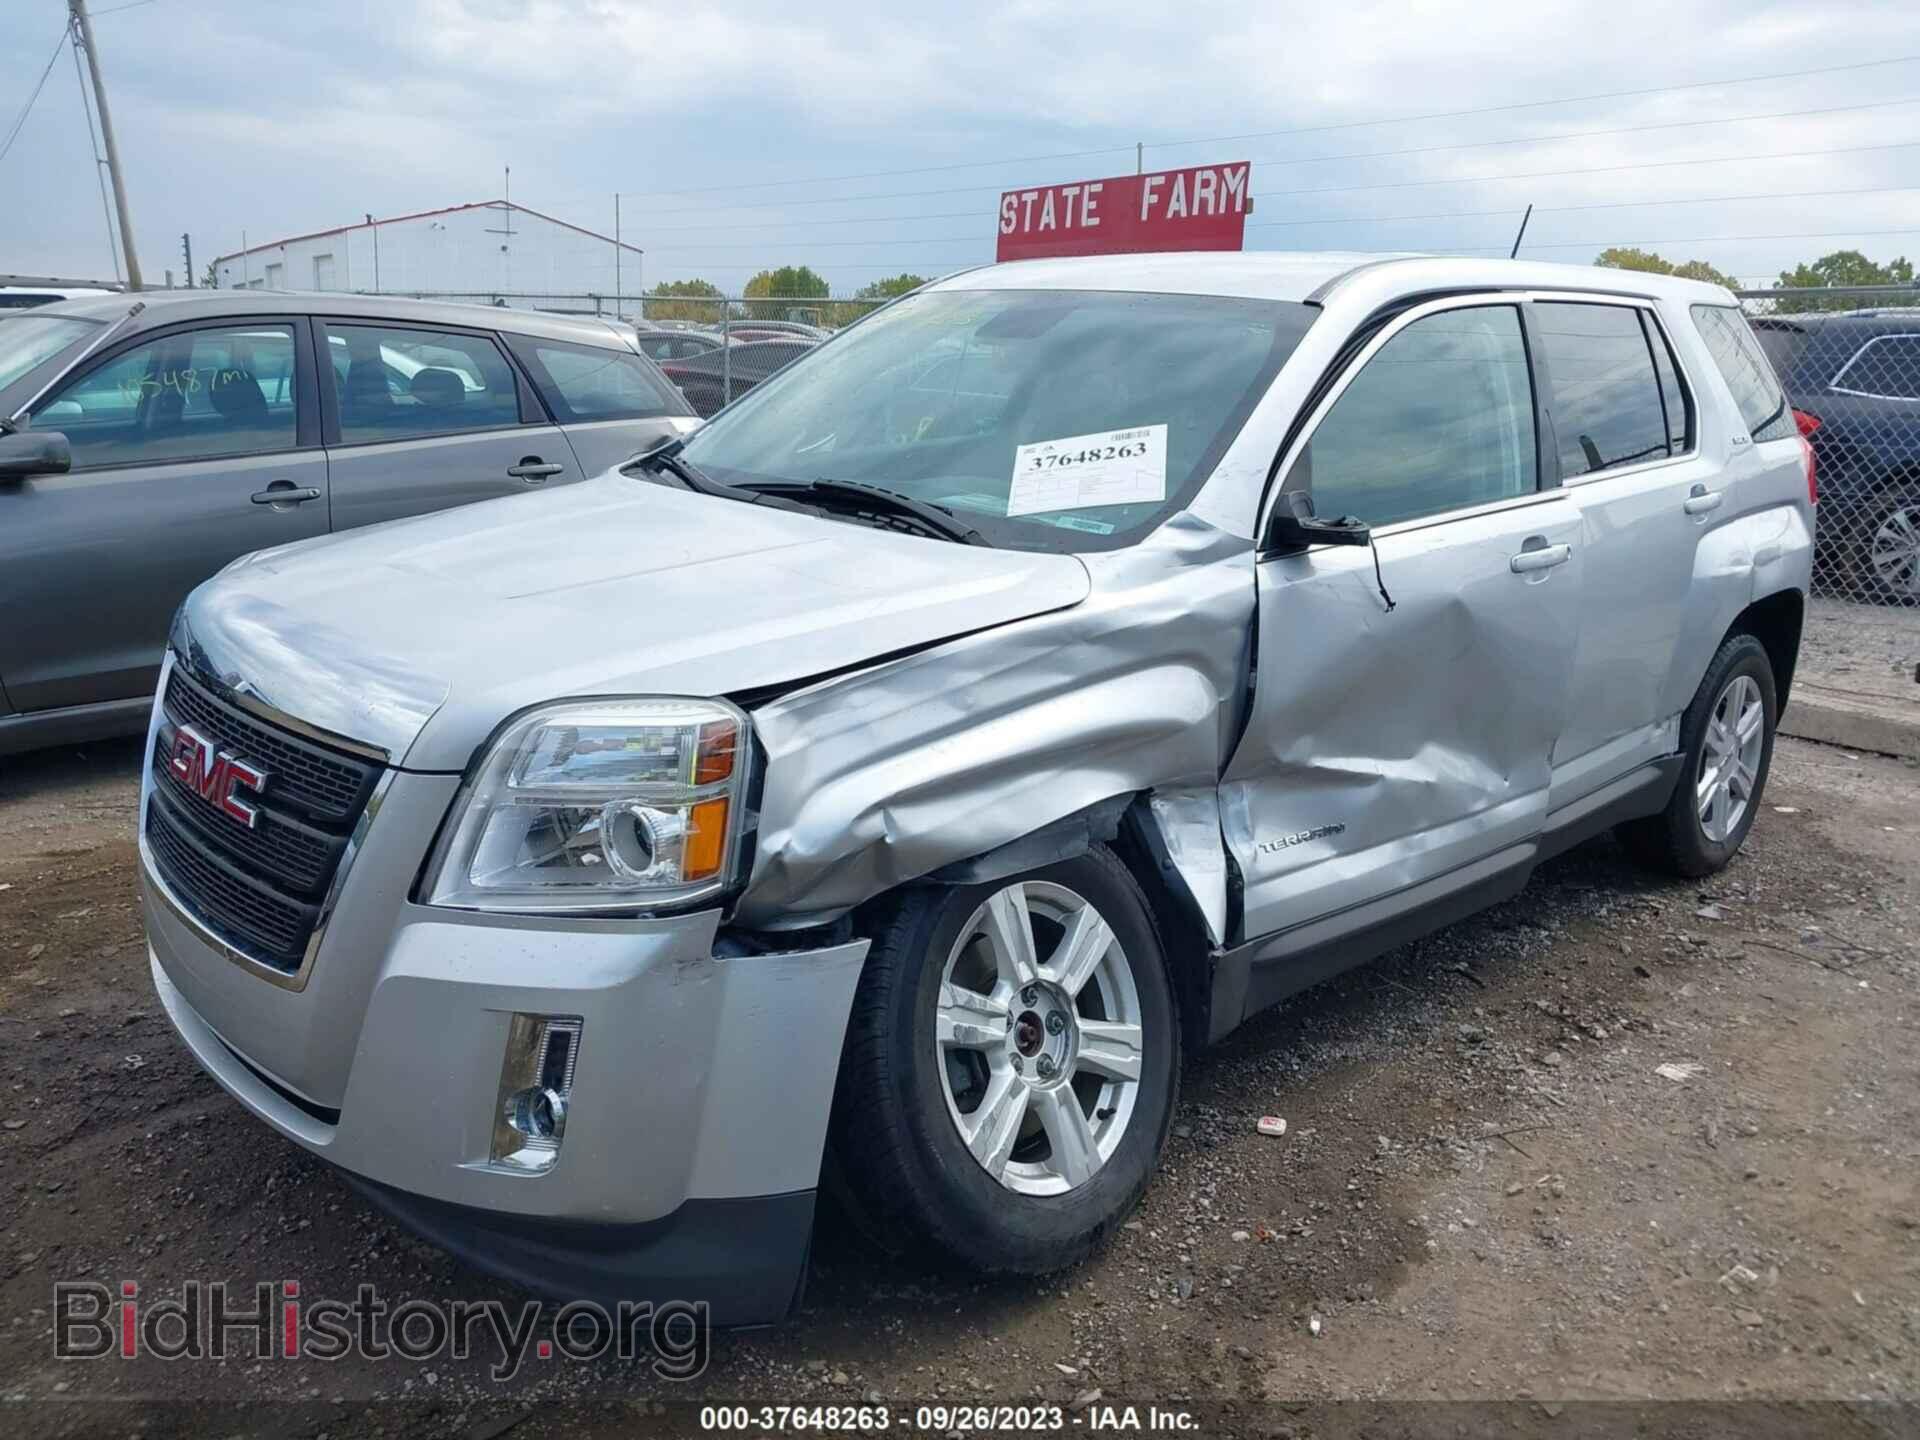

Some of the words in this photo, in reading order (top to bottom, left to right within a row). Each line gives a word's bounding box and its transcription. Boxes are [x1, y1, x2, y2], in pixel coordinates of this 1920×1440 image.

[1000, 183, 1103, 235] STATE
[1140, 165, 1248, 222] FARM
[1029, 442, 1147, 472] 37648263
[168, 724, 268, 829] GMC
[1258, 823, 1346, 854] TERRA
